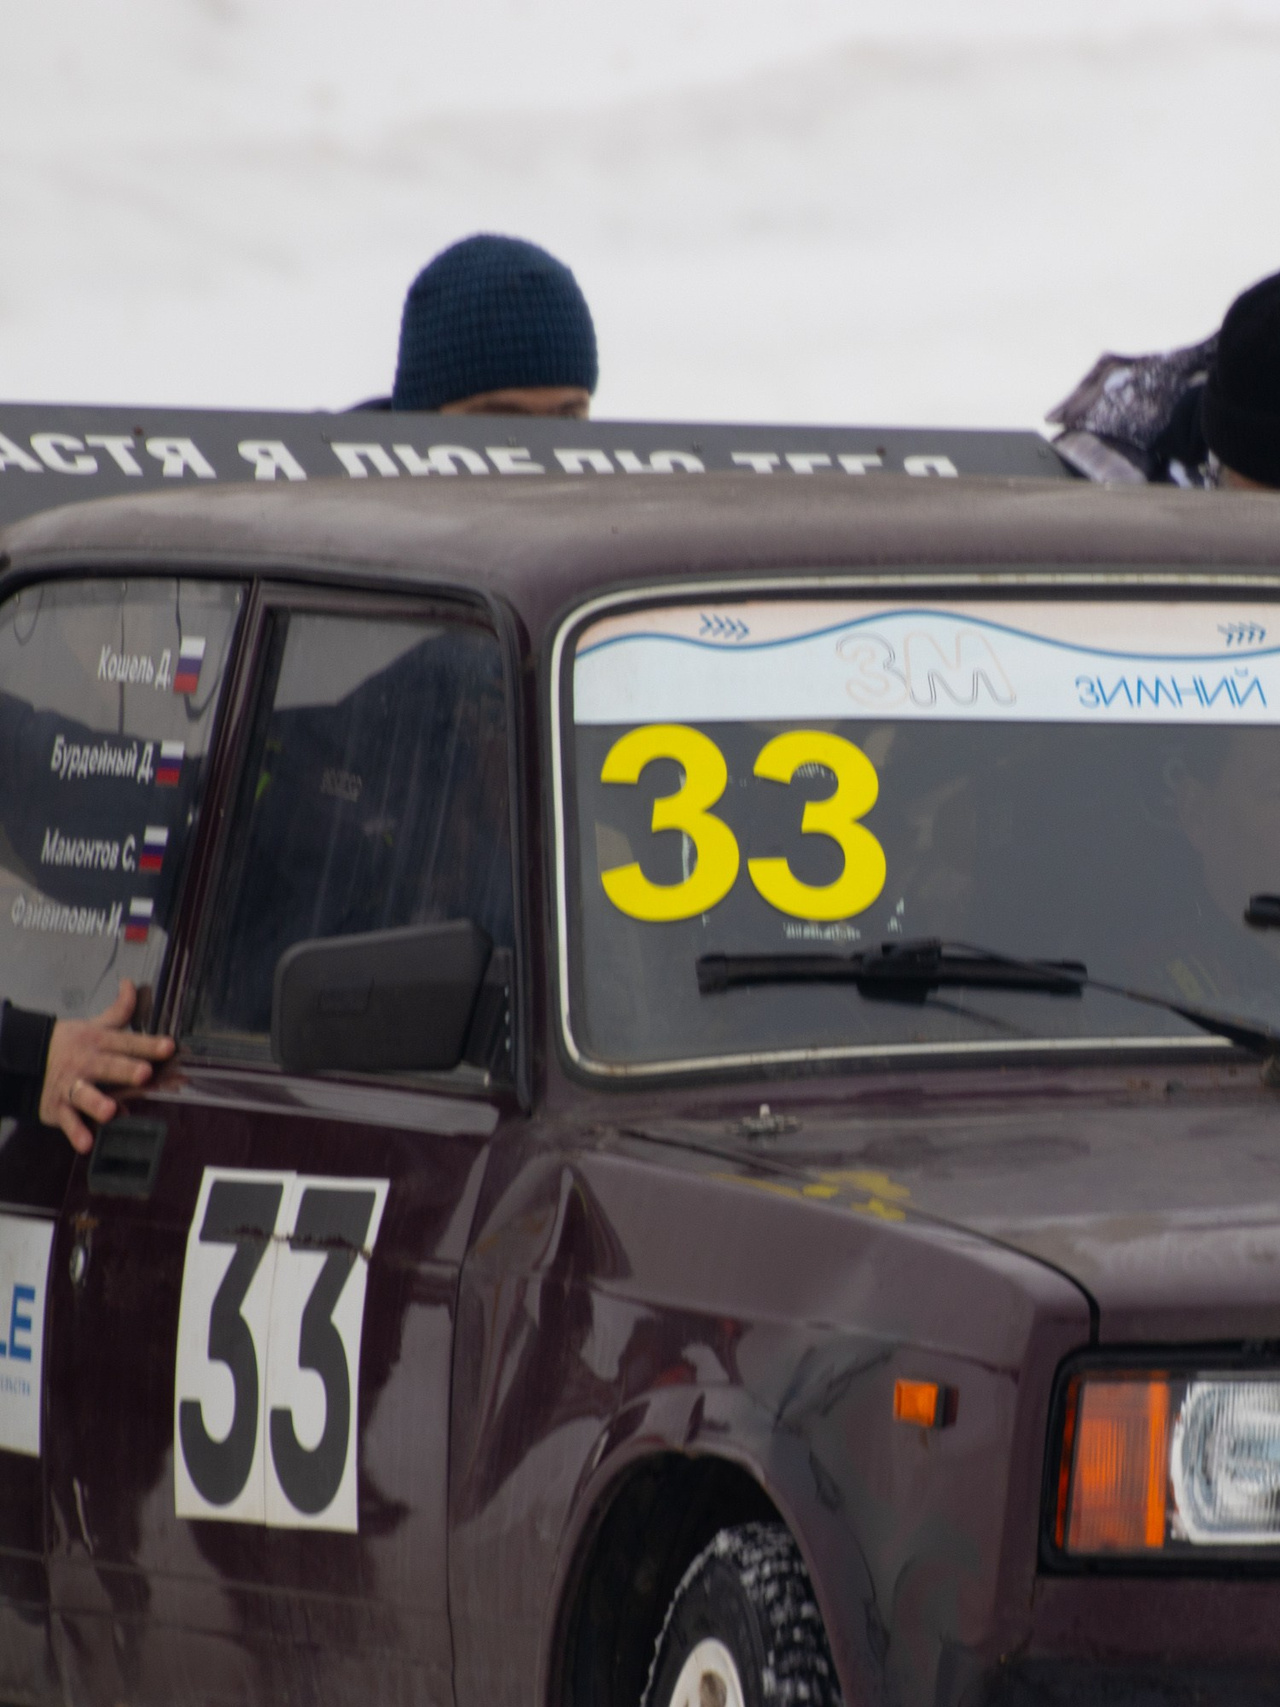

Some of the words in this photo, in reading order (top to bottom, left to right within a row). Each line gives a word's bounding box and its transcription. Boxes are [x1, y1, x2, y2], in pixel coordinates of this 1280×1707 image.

[237, 440, 308, 481] Я
[97, 644, 155, 684] Кошель
[1074, 666, 1267, 710] ЗИМНИЙ
[51, 733, 138, 781] Бурдейный
[600, 722, 887, 923] 33
[41, 826, 121, 872] Мамонтов
[121, 833, 137, 874] С.
[179, 1179, 376, 1515] 33
